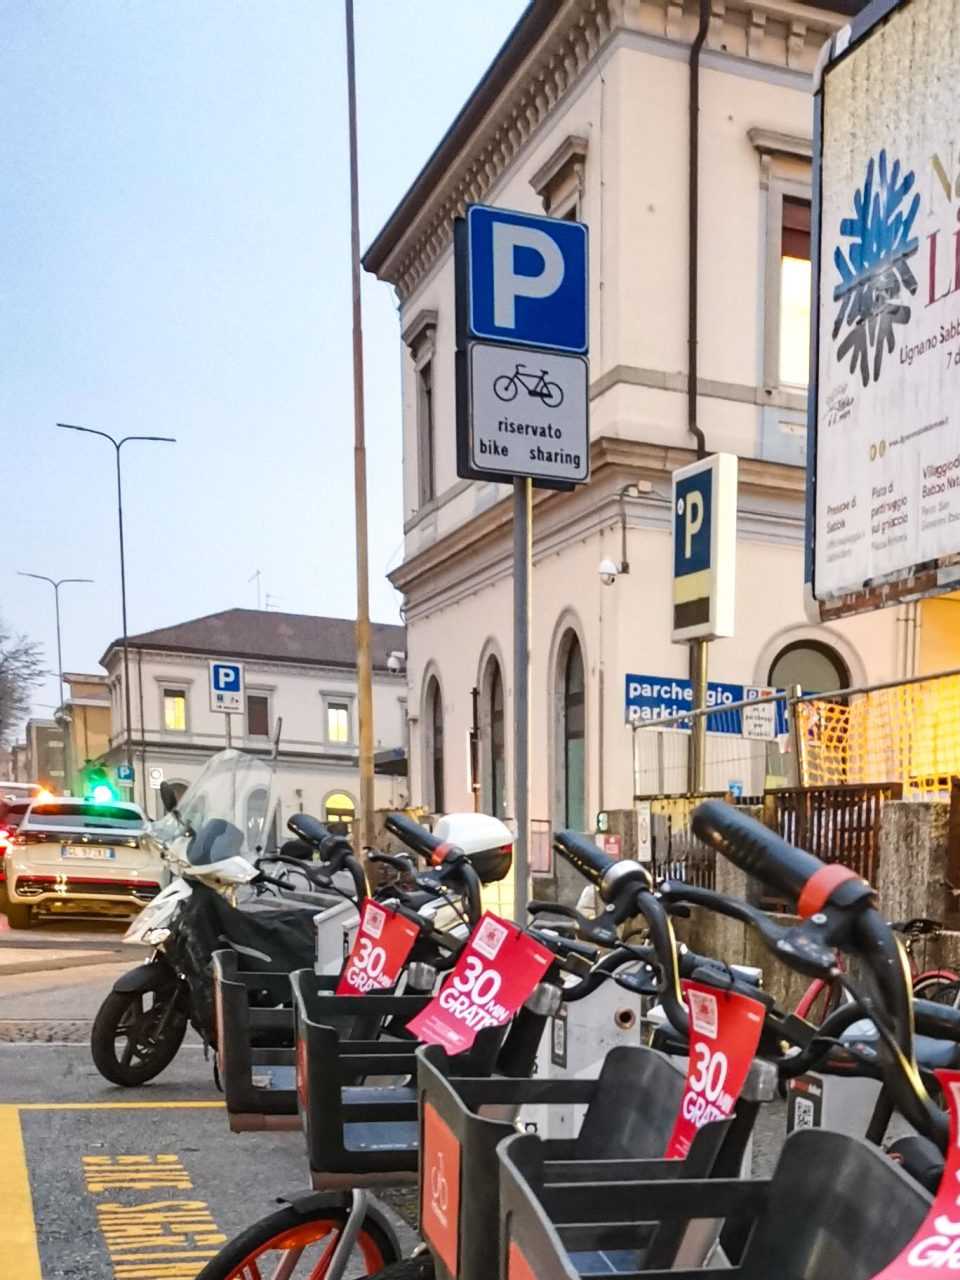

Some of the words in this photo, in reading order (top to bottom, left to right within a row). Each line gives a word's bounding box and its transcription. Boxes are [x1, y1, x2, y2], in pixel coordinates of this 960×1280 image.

[493, 222, 565, 328] P
[899, 332, 938, 366] Lignano
[498, 417, 562, 440] riservato
[480, 438, 509, 457] bike
[529, 445, 581, 469] sharing
[684, 489, 704, 560] P
[218, 667, 235, 689] P
[629, 682, 733, 706] parchegio
[120, 768, 130, 778] P
[353, 937, 387, 978] 30
[453, 955, 502, 1005] 30
[689, 1042, 728, 1102] 30
